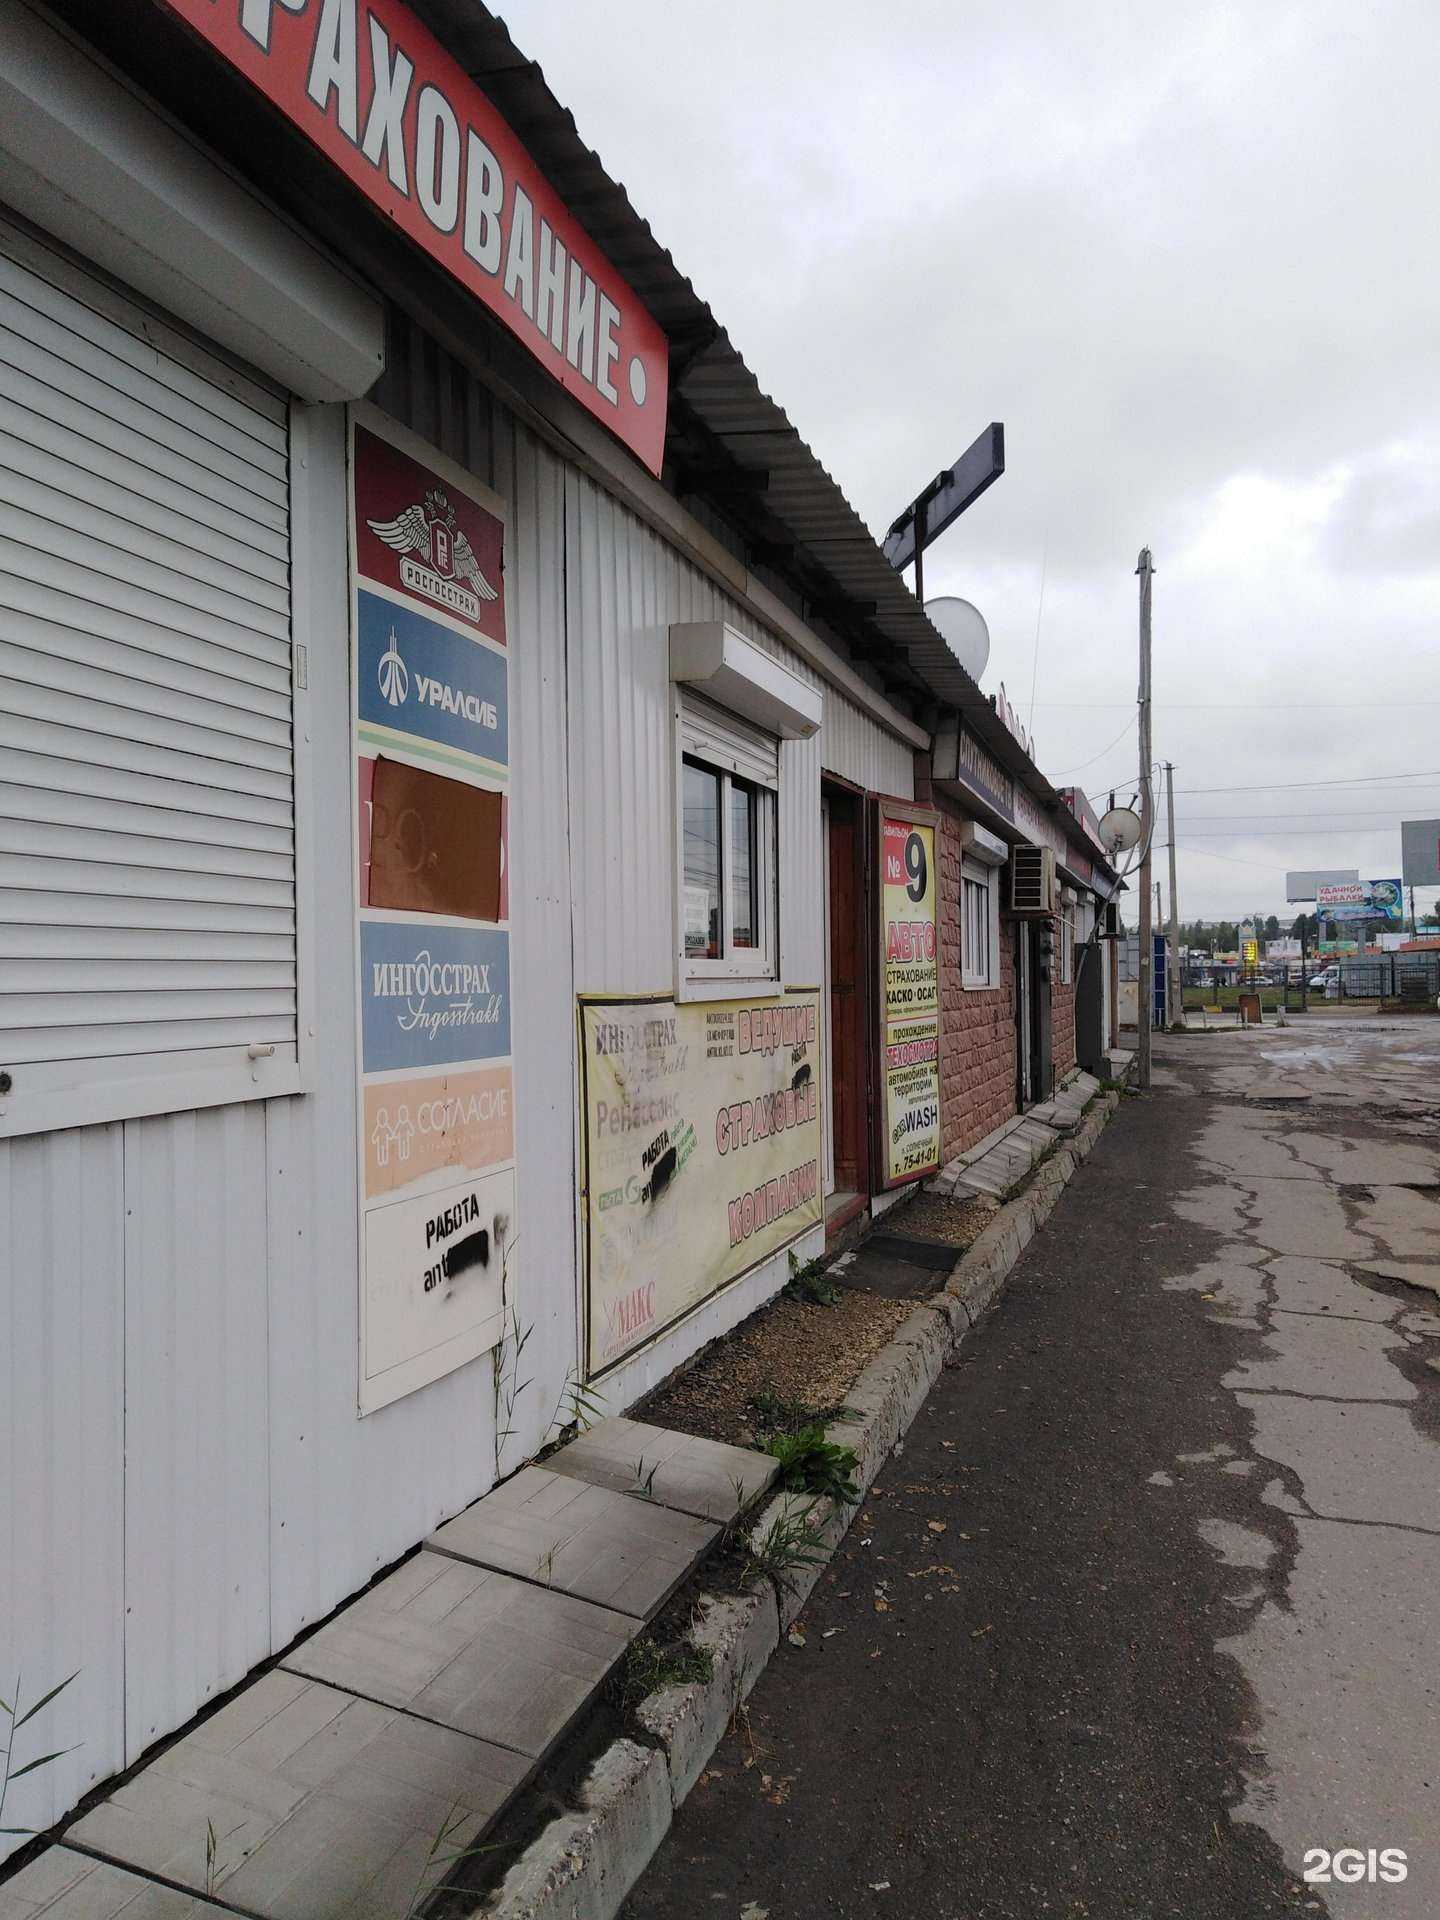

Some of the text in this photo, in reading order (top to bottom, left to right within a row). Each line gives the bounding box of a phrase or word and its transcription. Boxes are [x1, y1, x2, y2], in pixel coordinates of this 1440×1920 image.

[407, 567, 475, 614] РОСГОССТРАХ
[414, 673, 498, 730] УРАЛСИБ
[905, 831, 928, 903] 9
[886, 921, 936, 963] АВТО
[373, 951, 490, 997] ИНГОССТРАХ
[887, 968, 937, 985] СТРАХОВАНИЕ
[397, 994, 502, 1040] Ingosstrakh
[739, 1005, 815, 1057] ВЕДУЩИЕ
[893, 1023, 937, 1042] прохождение
[888, 1066, 928, 1087] автомобиля
[894, 1079, 933, 1099] территории
[417, 1088, 508, 1134] СОГЛАСИЕ
[716, 1082, 816, 1156] СТРАХОВЫЕ
[642, 1129, 669, 1171] РАБОТА
[426, 1193, 479, 1249] РАБОТА
[728, 1159, 816, 1248] КОМПАНИИ
[618, 1280, 655, 1338] МАКС
